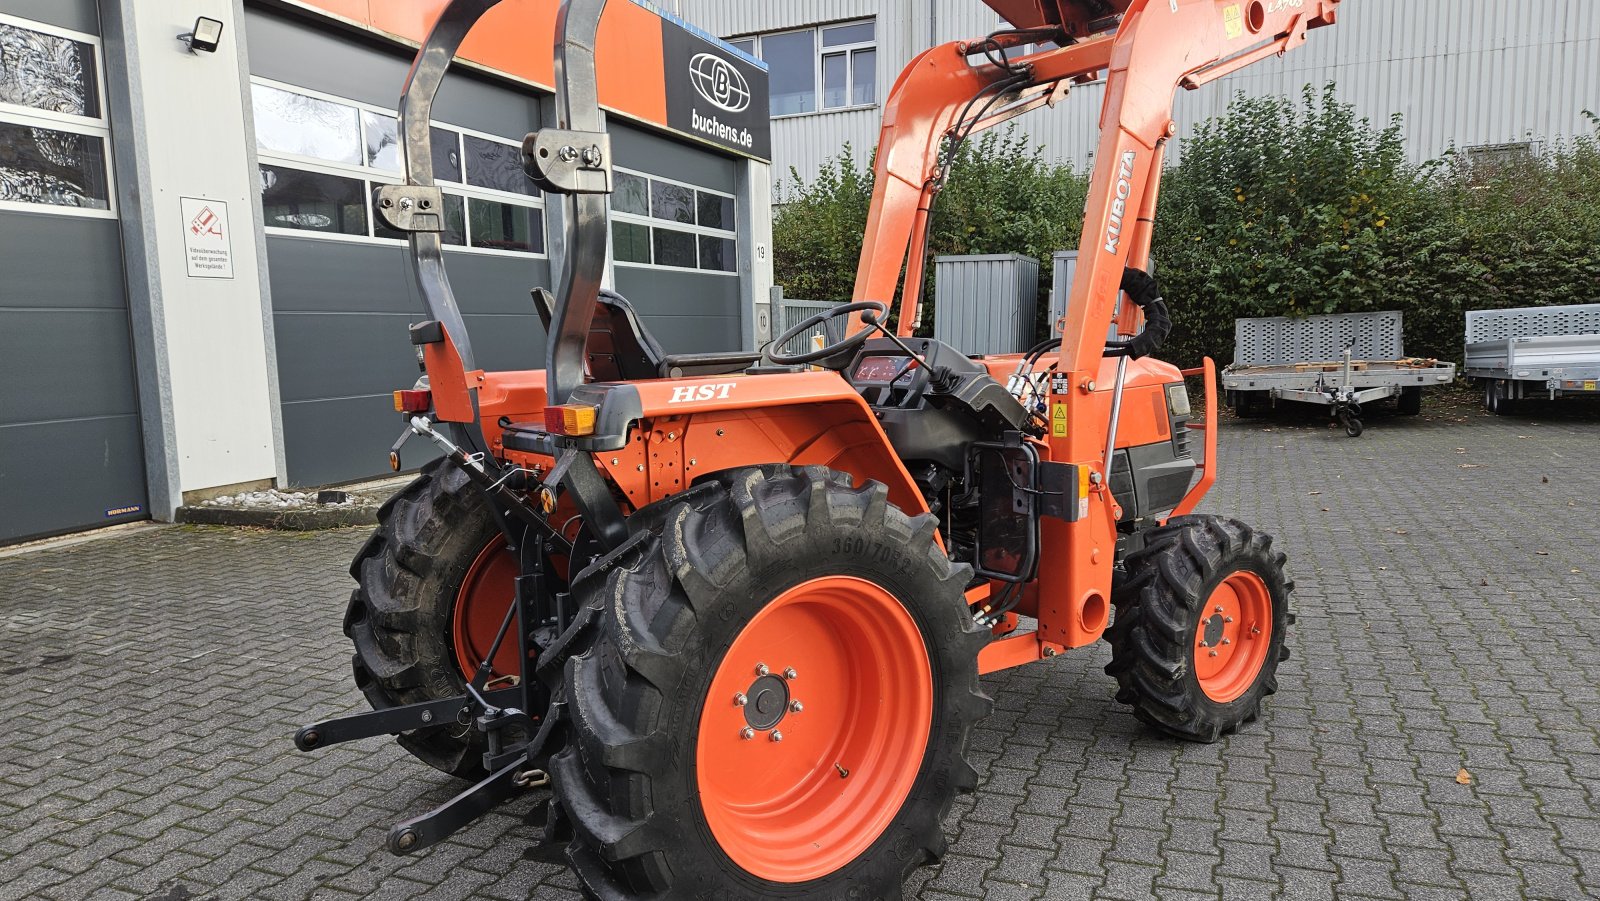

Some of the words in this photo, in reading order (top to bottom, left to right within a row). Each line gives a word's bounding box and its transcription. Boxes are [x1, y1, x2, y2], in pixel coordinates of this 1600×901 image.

[692, 108, 752, 148] buchens.de
[1104, 150, 1136, 255] KUBOTA
[757, 246, 765, 259] 19
[668, 382, 737, 404] HST
